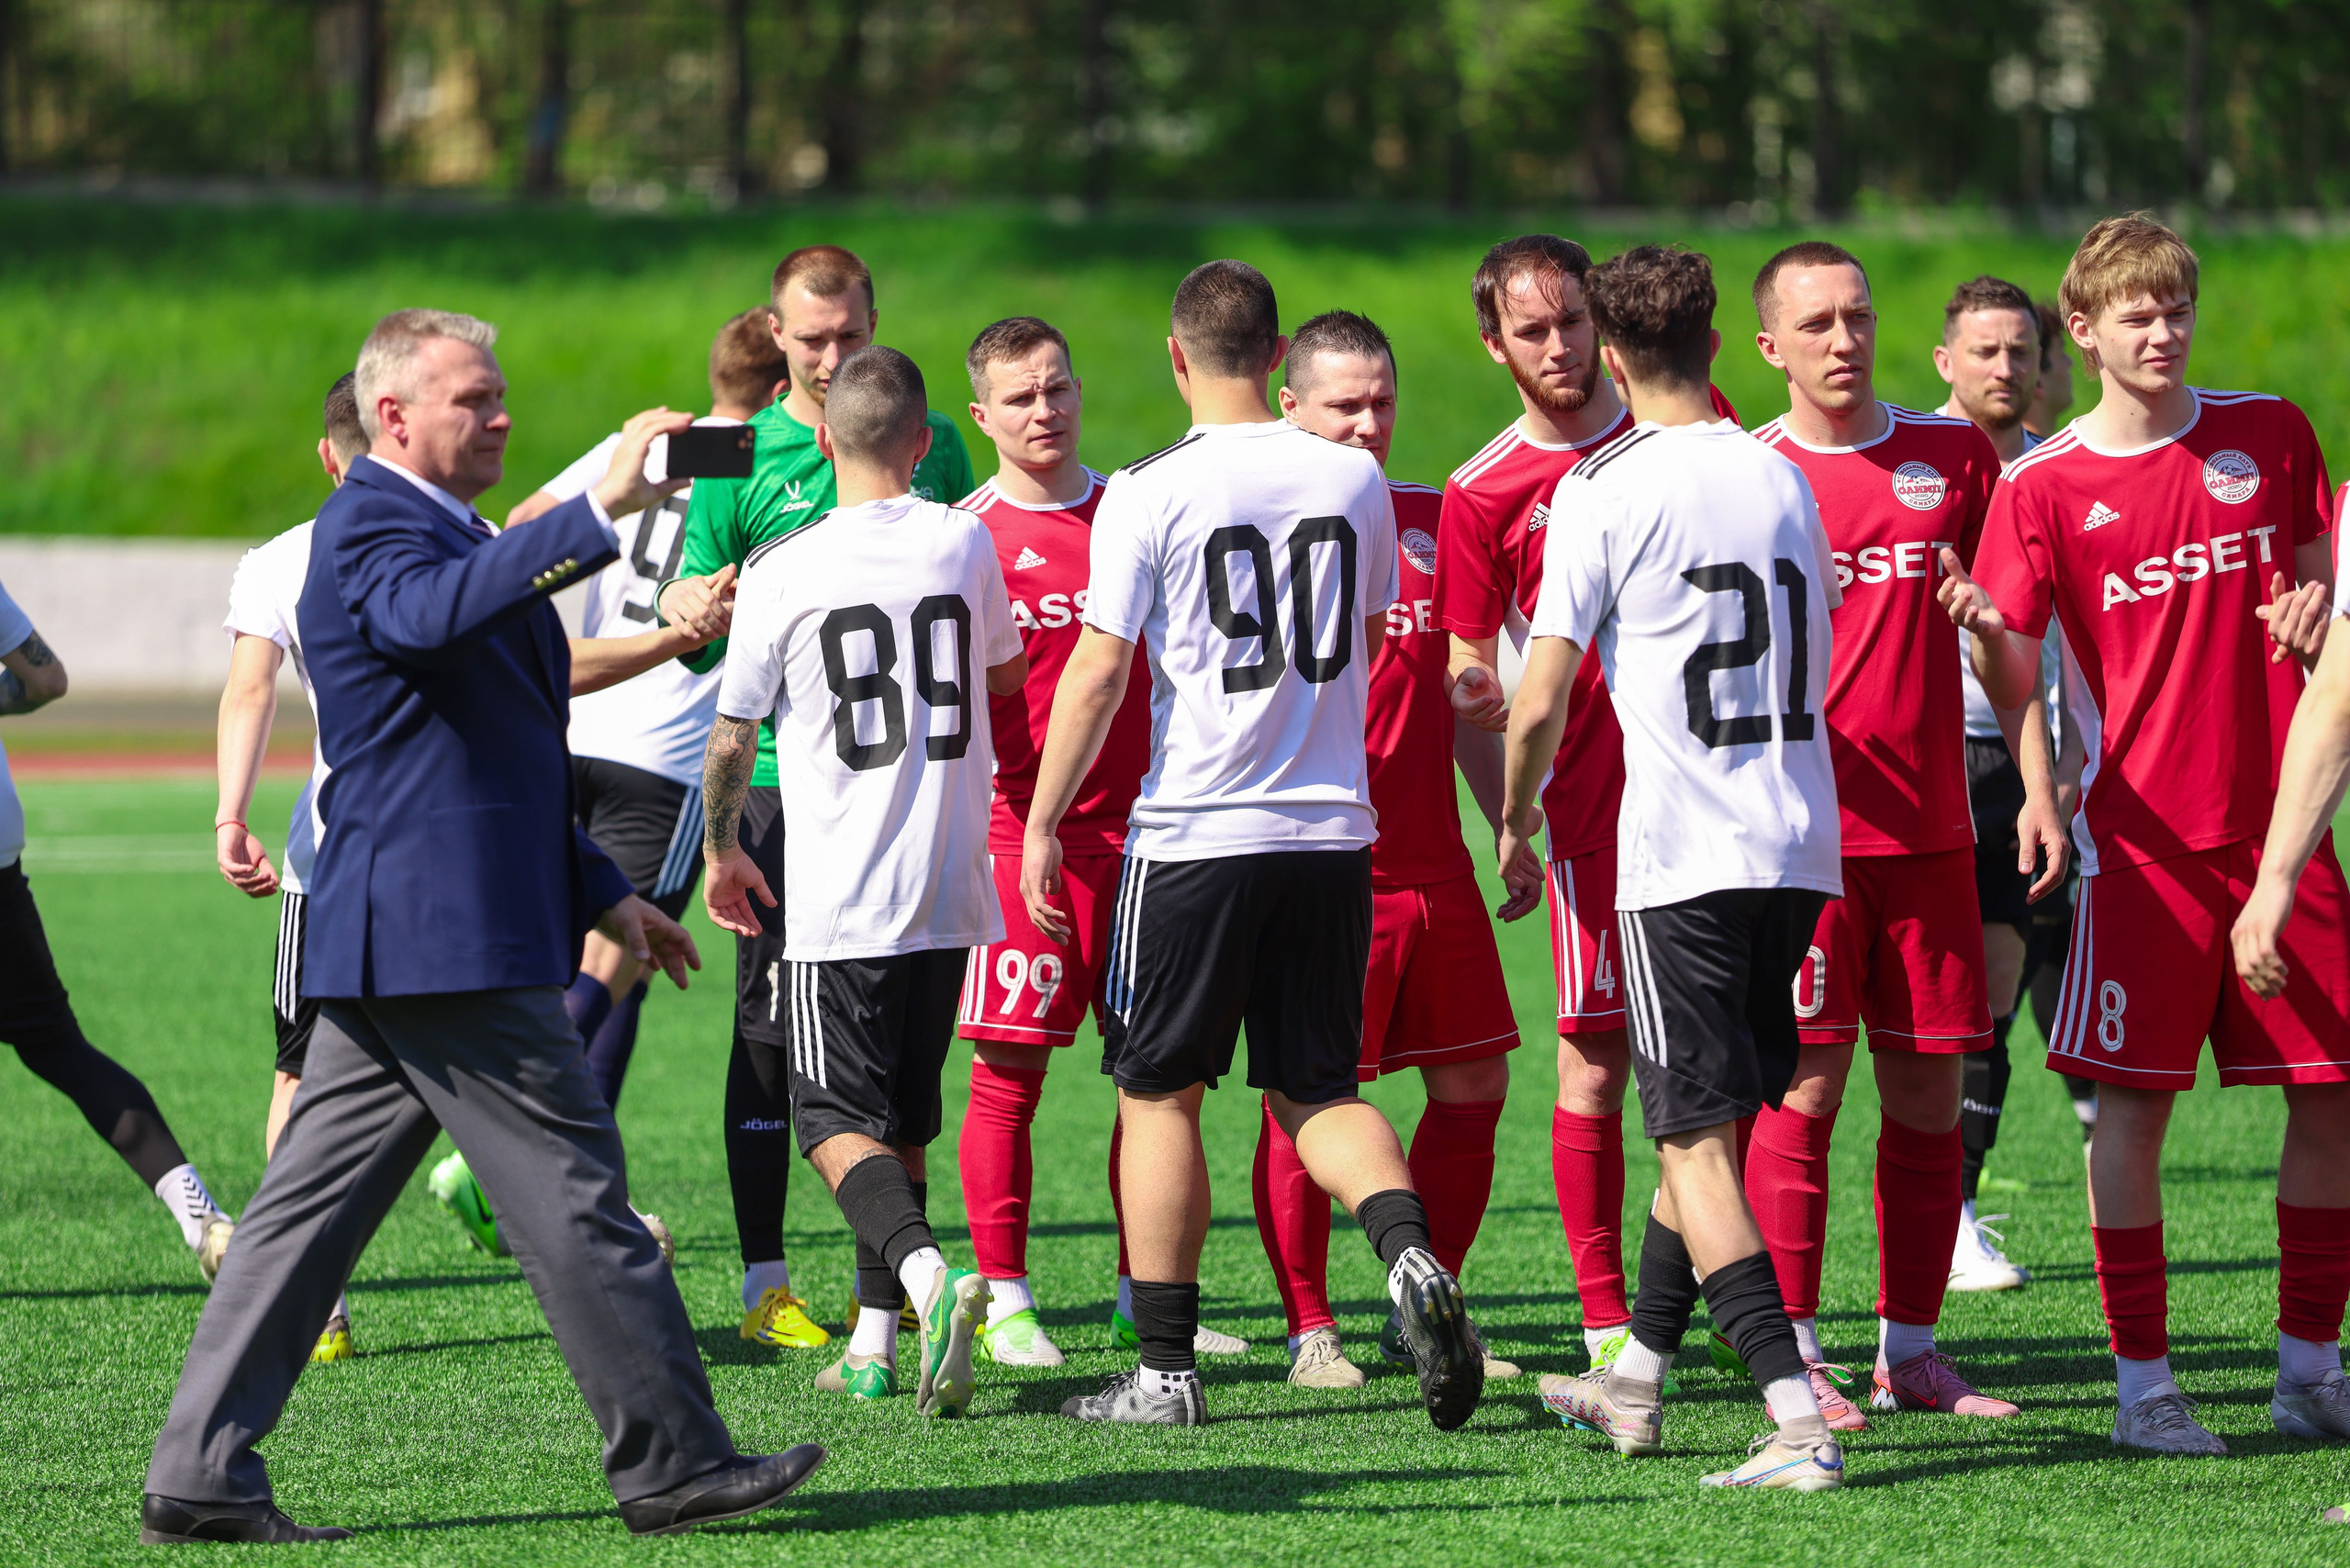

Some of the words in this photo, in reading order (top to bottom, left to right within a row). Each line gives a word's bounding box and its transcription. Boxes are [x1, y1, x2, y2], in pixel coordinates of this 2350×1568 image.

[2083, 511, 2121, 532] adidas
[1014, 556, 1047, 571] adidas
[2102, 524, 2277, 612] ASSET
[1204, 515, 1358, 695] 90
[819, 594, 971, 772] 89
[1680, 557, 1815, 749] 21
[996, 948, 1063, 1019] 99
[1595, 929, 1616, 1000] 4
[2097, 979, 2127, 1053] 8
[740, 1117, 788, 1130] JÖGEL
